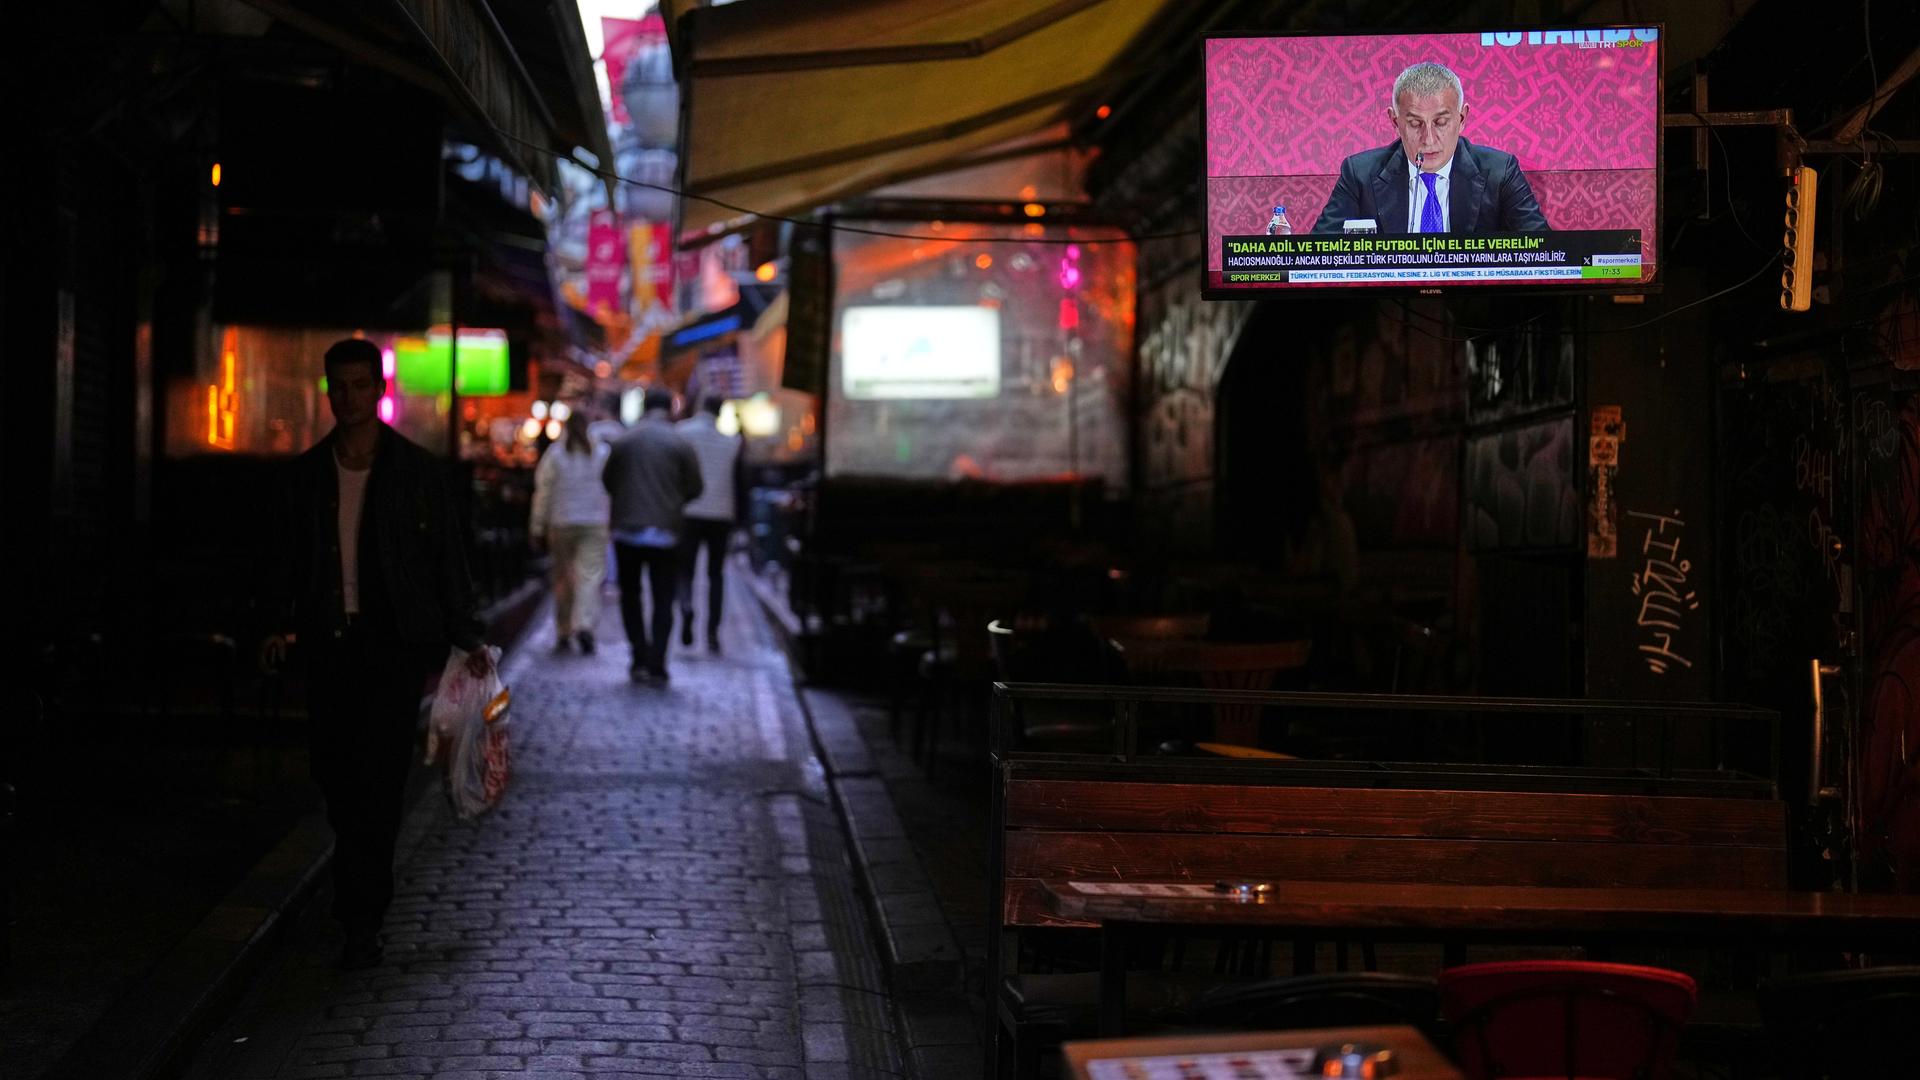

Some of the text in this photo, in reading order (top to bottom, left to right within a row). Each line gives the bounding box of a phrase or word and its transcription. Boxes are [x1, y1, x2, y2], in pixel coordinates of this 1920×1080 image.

[1228, 236, 1544, 253] "DAHA ADİL VE TEMİZ BİR FUTBOL İÇİN EL ELE VERELİM"
[1228, 250, 1566, 267] HACIOSMANOĞLU: ANCAK BU ŞEKİLDE TÜRK FUTBOLUNU ÖZLENEN YARINLARA TAŞIYABİLİRİZ
[1230, 272, 1281, 282] SPOR MERKEZİ
[1495, 269, 1533, 277] MÜSABAKA
[1601, 268, 1621, 276] 17:33
